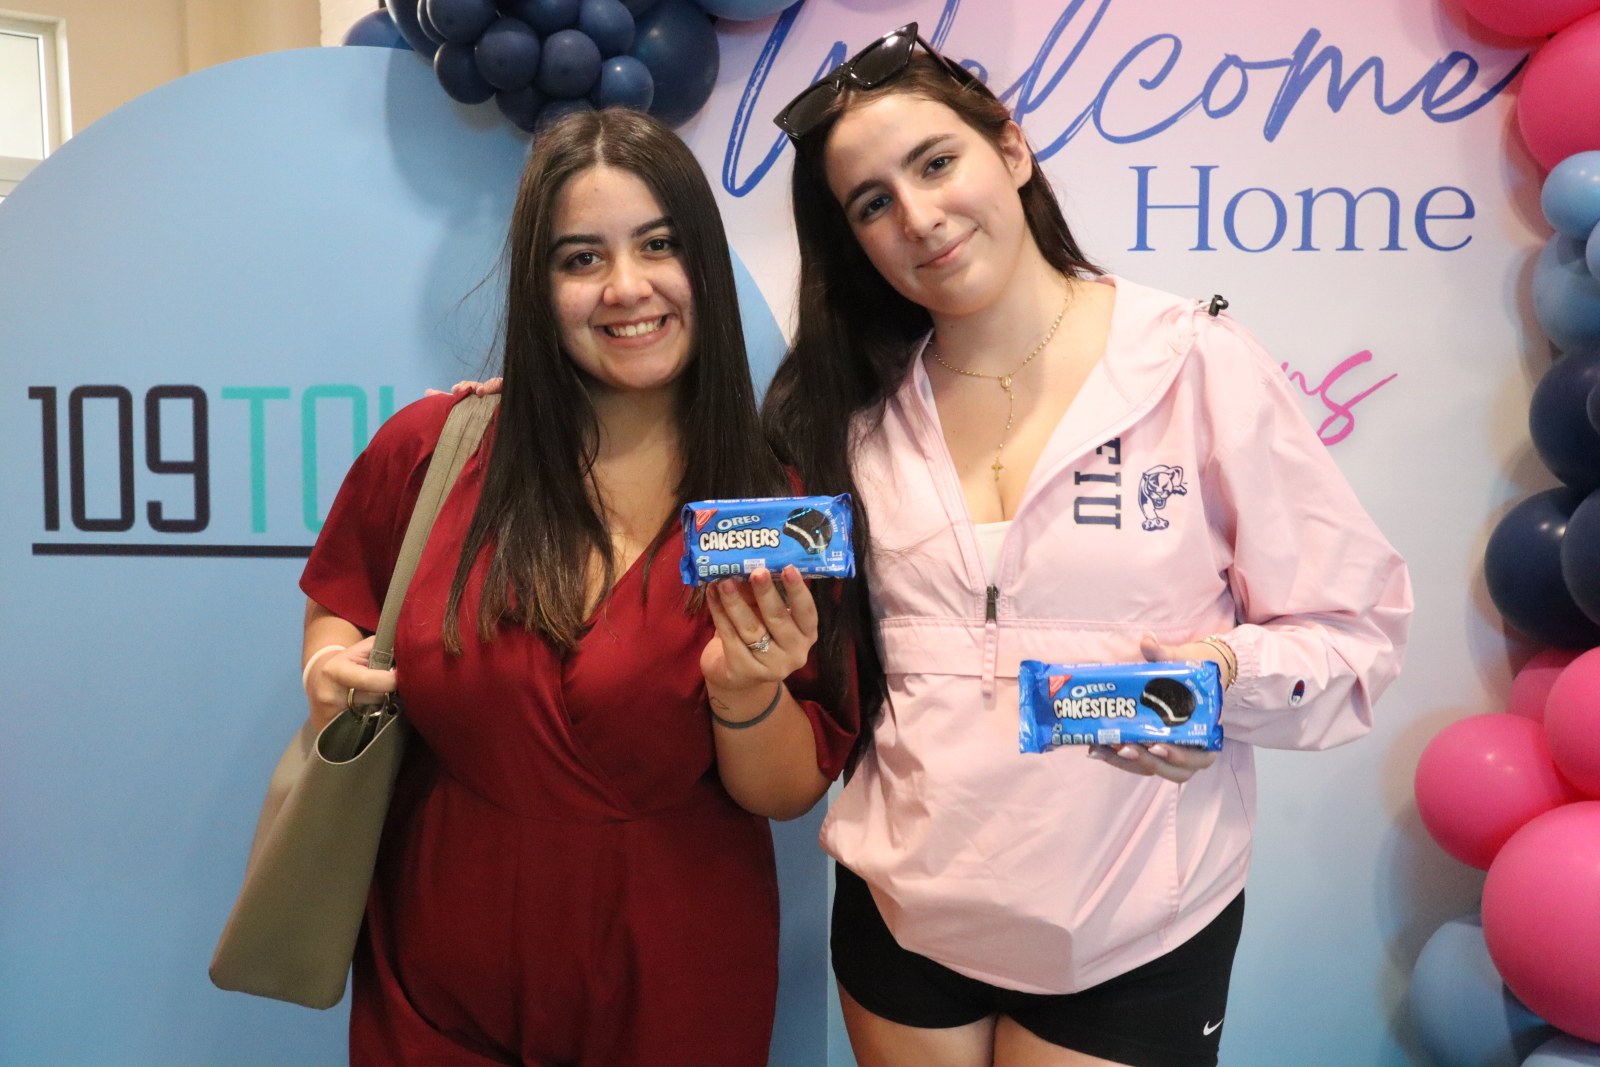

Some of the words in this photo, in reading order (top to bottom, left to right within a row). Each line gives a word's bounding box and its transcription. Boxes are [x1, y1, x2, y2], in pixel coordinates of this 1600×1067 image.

[722, 0, 1530, 197] Wlcome
[1127, 165, 1475, 252] Home
[716, 514, 761, 531] OREO
[699, 527, 780, 551] CAKESTERS
[1070, 682, 1116, 698] OREO
[1053, 697, 1137, 719] CAKESTERS
